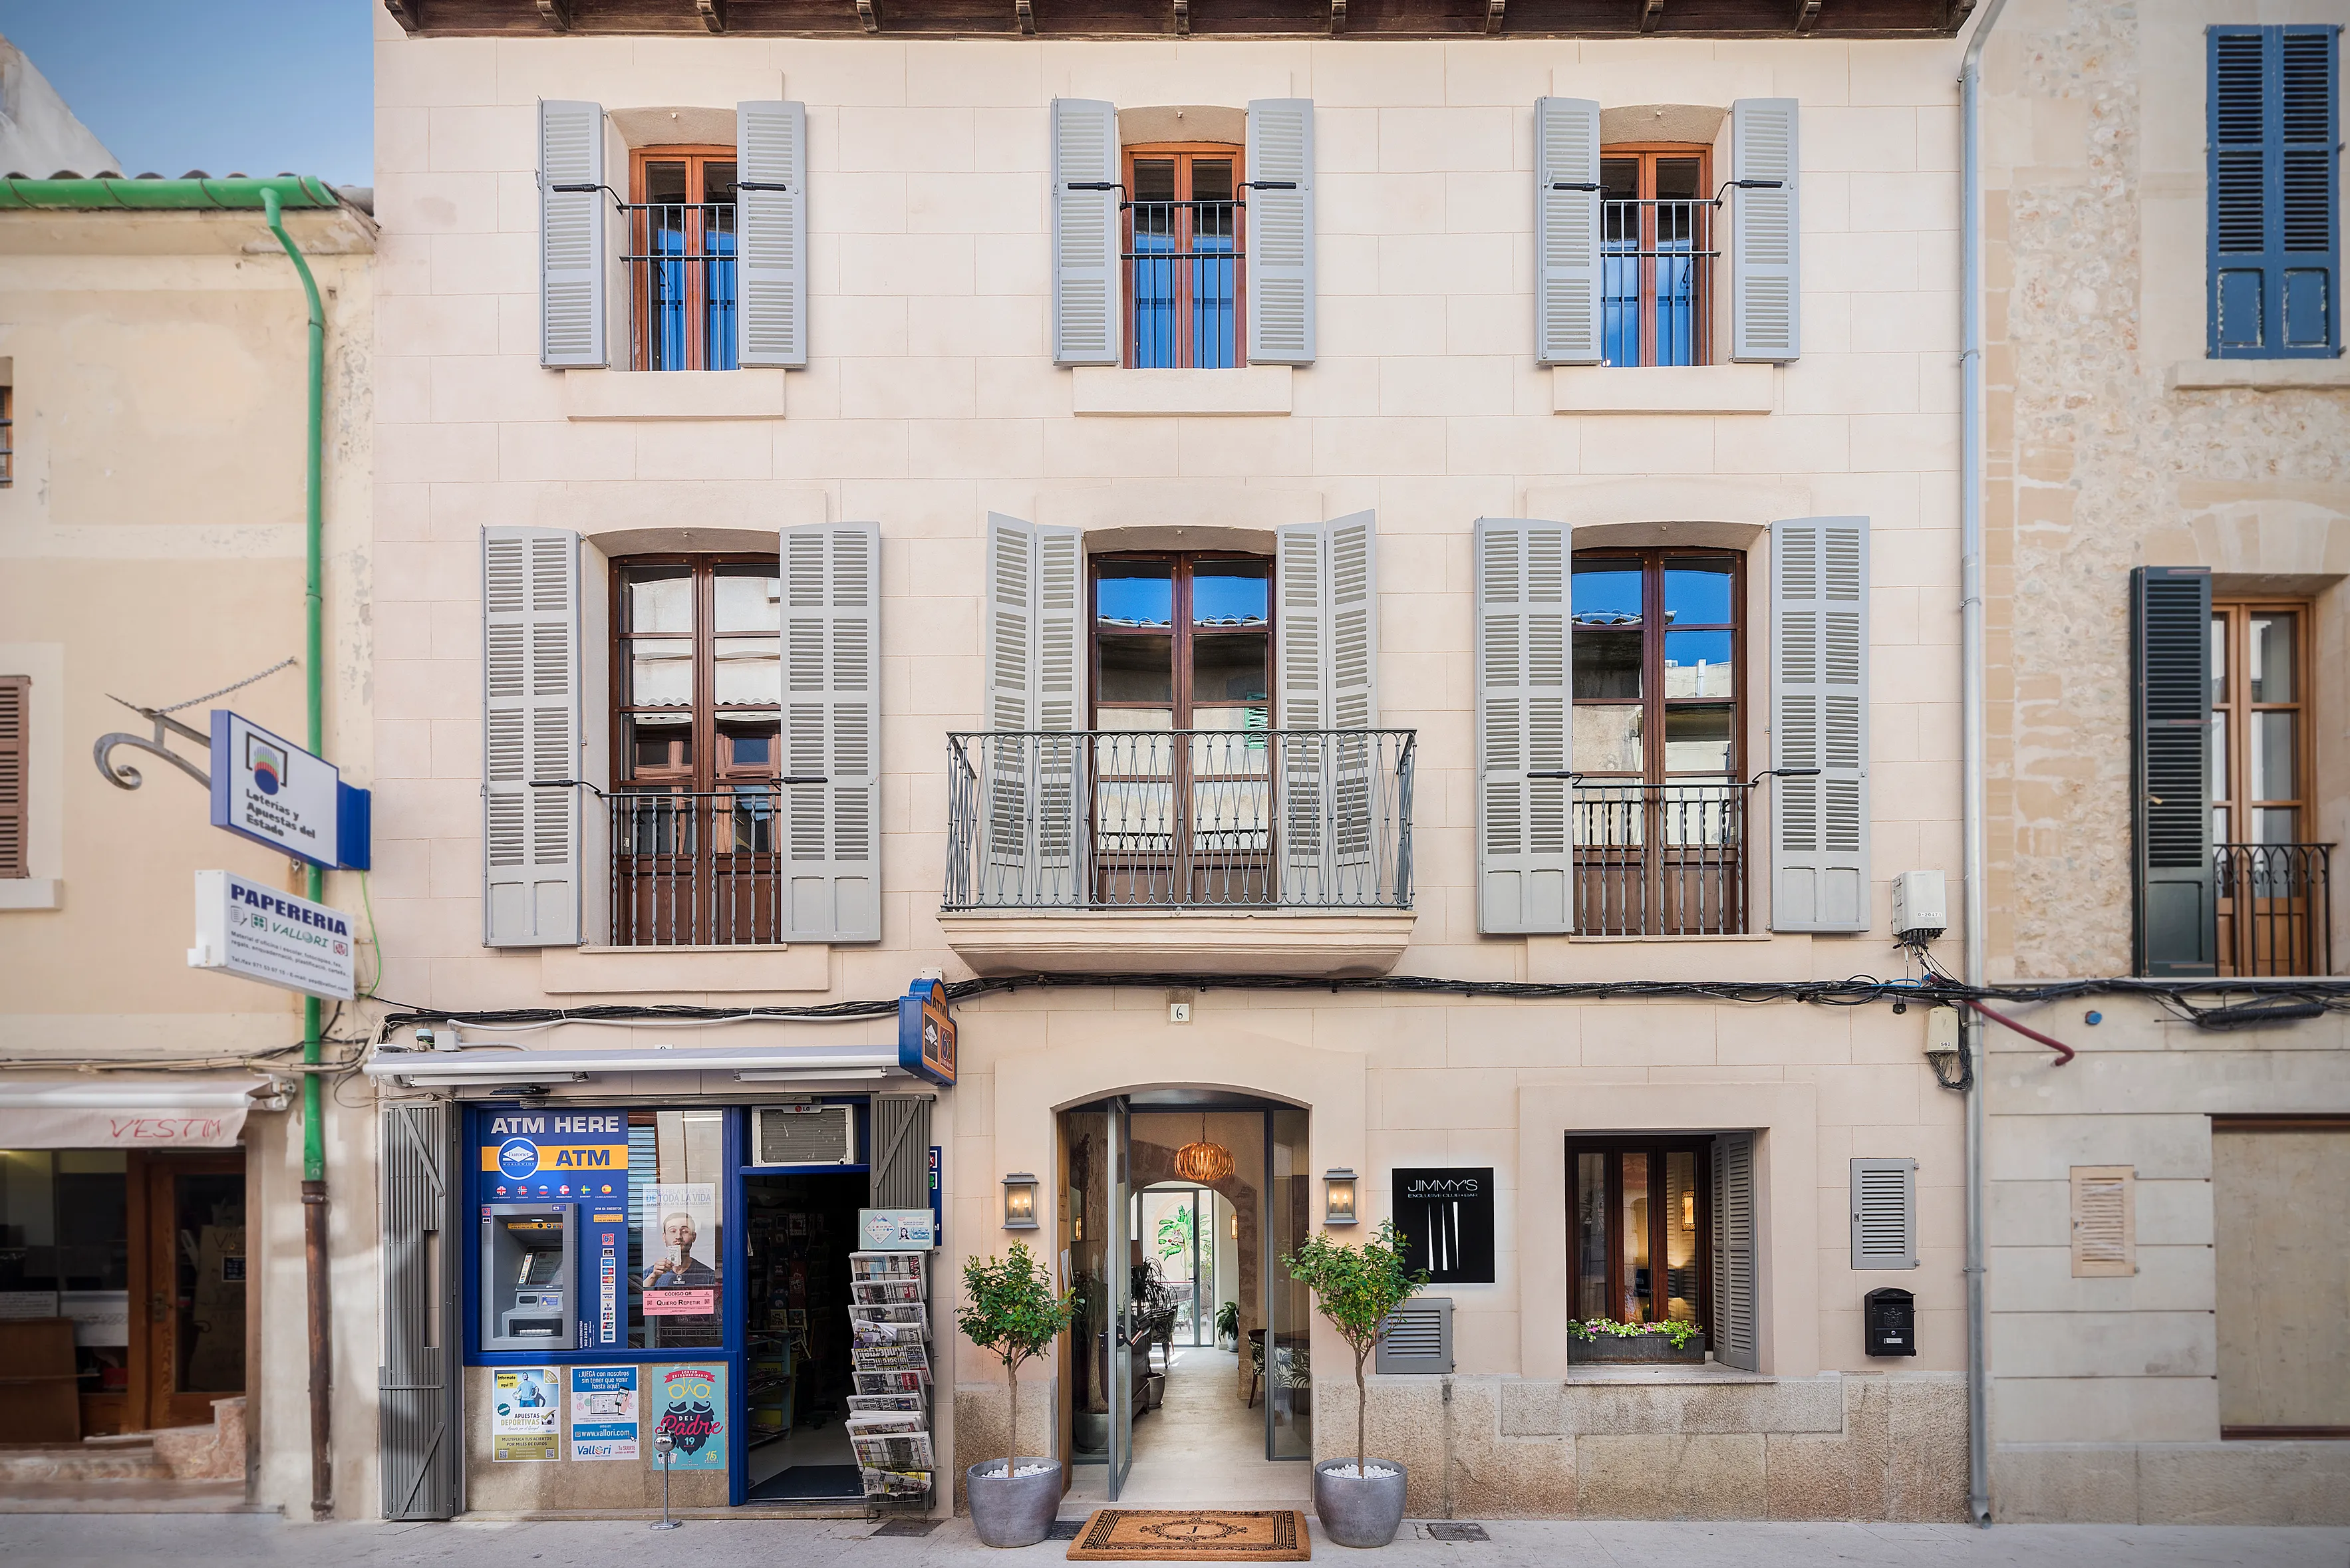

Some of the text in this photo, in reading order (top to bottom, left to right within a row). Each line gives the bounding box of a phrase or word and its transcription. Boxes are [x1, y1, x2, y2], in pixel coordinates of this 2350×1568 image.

[247, 802, 316, 839] Apuestas del
[293, 811, 300, 821] y
[246, 813, 285, 837] Estado
[231, 883, 347, 936] PAPERERIA
[231, 930, 253, 942] Material
[932, 996, 947, 1019] ATM
[1176, 1005, 1183, 1020] 6
[491, 1116, 619, 1134] ATM HERE
[555, 1149, 611, 1166] ATM
[1407, 1179, 1478, 1192] JIMMY'S
[581, 1428, 630, 1437] www.vallori.com
[655, 1414, 724, 1436] Padre
[684, 1436, 695, 1445] 19
[706, 1450, 718, 1461] 15
